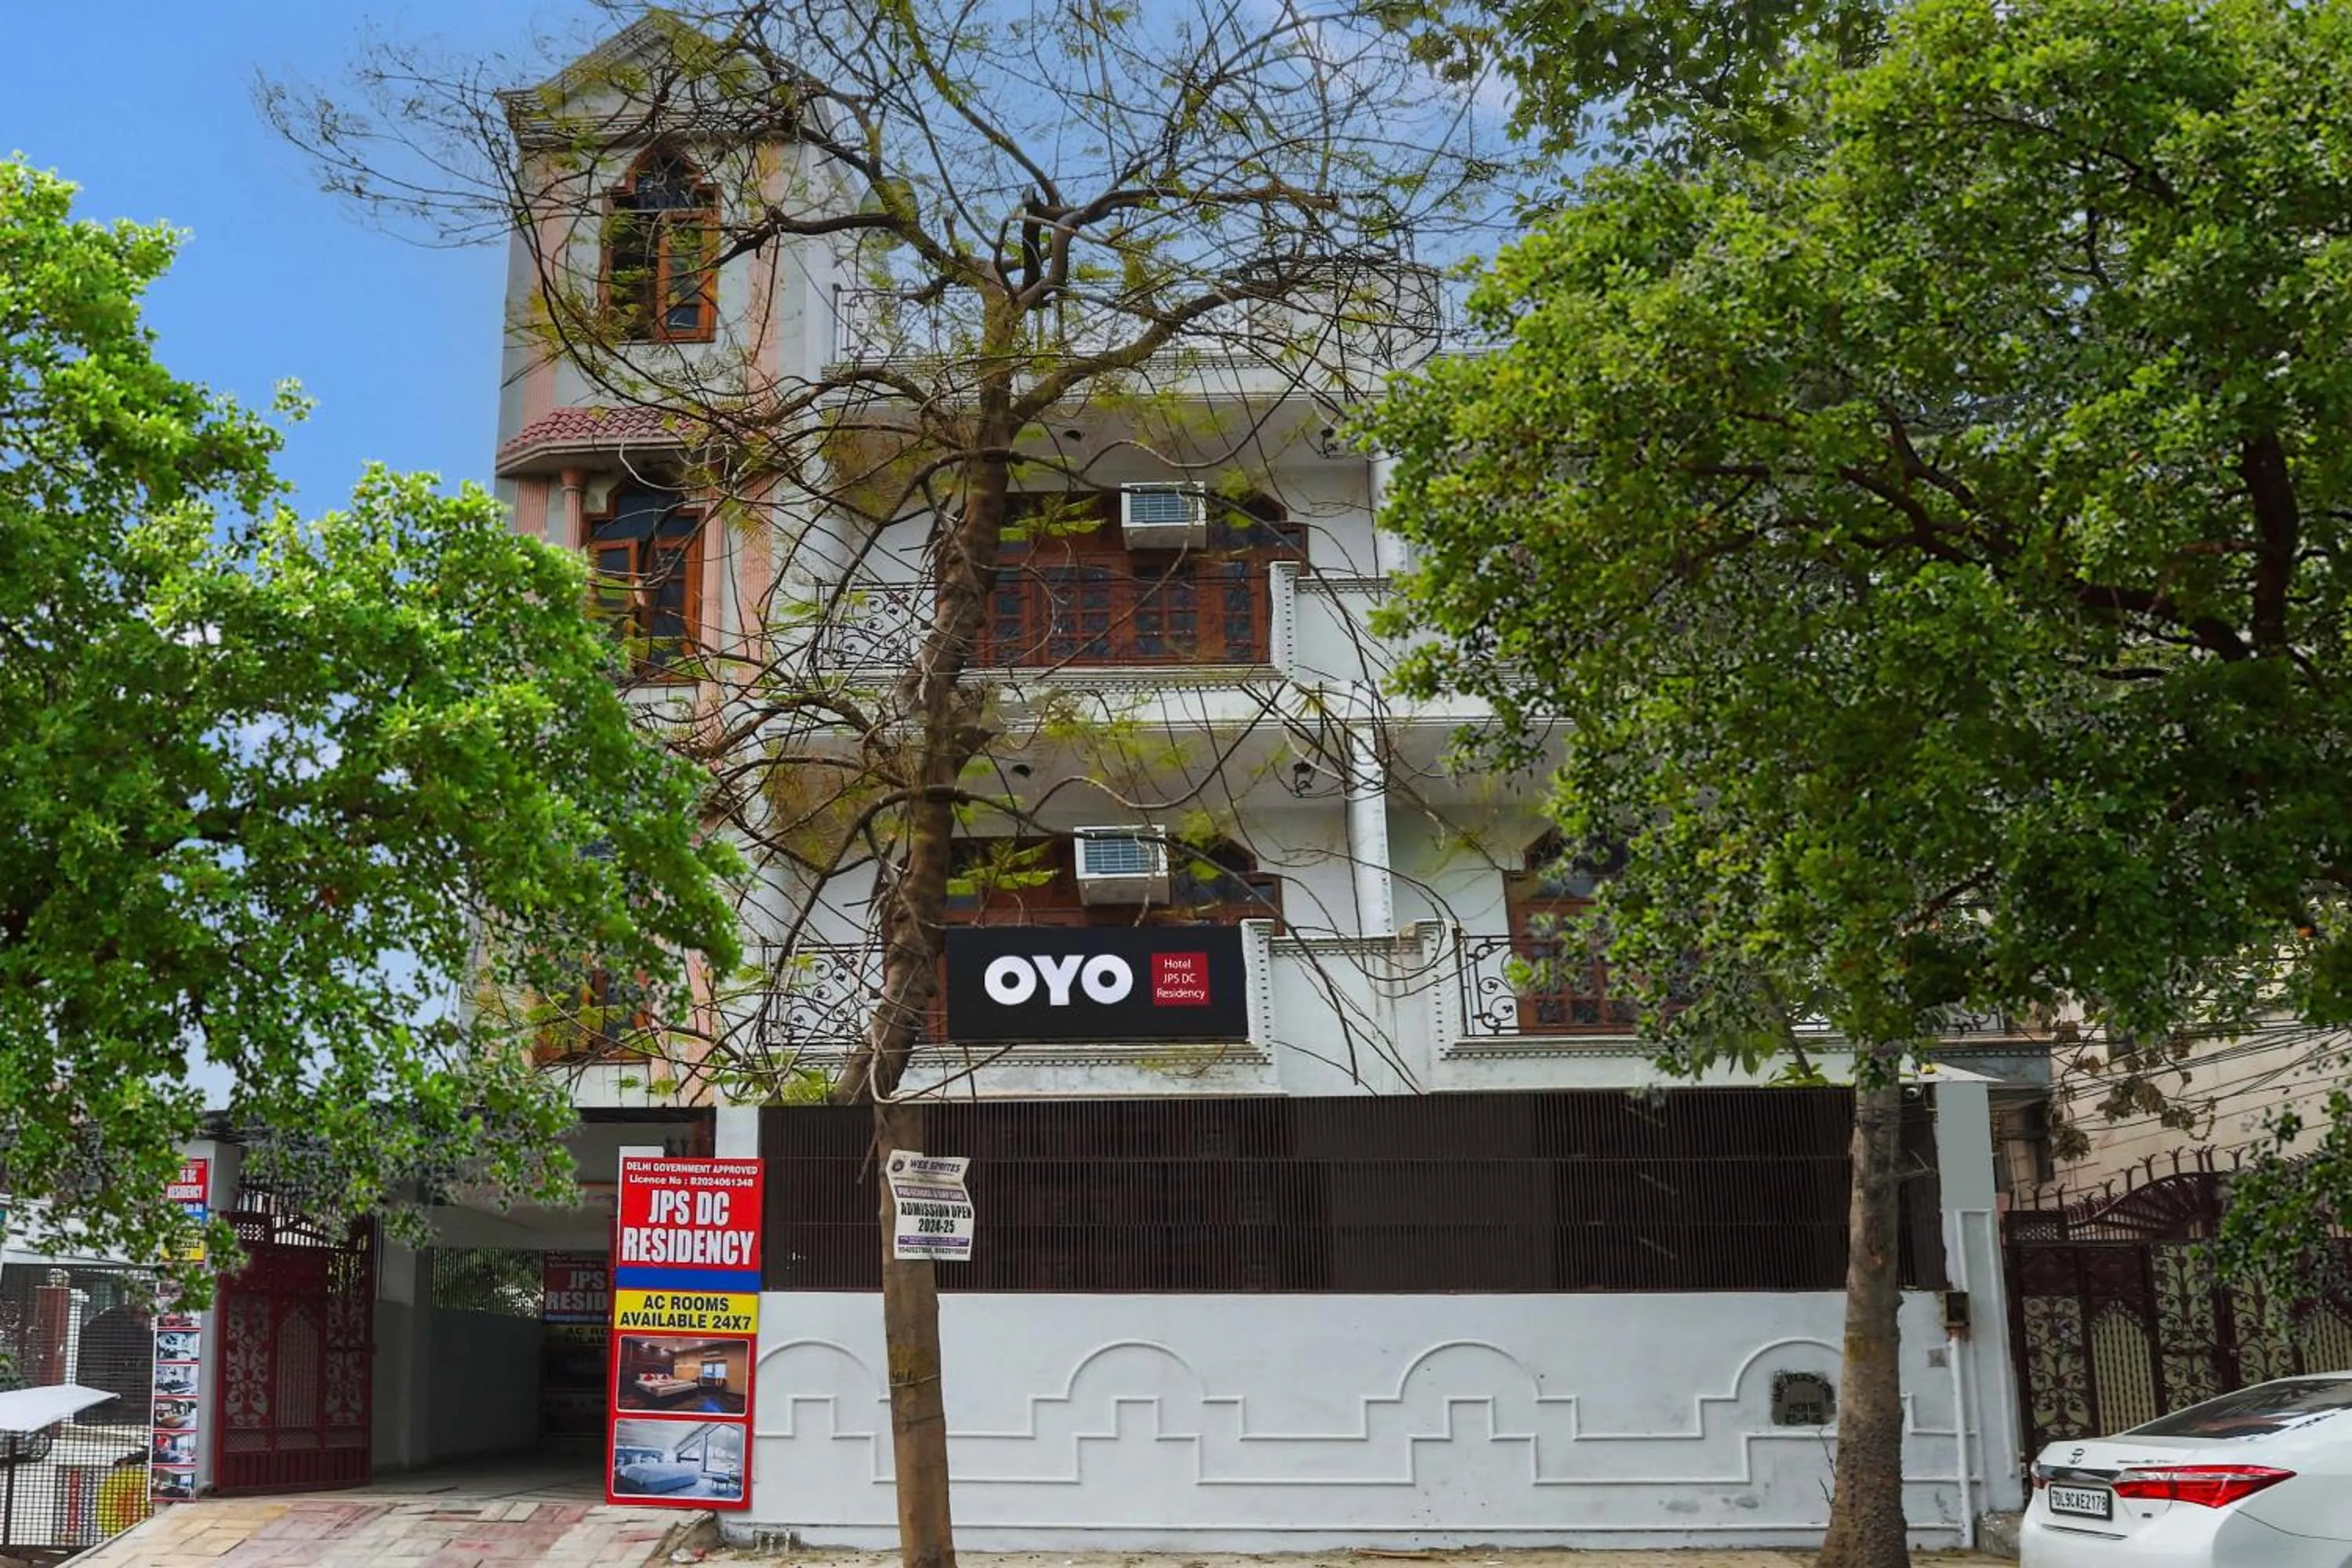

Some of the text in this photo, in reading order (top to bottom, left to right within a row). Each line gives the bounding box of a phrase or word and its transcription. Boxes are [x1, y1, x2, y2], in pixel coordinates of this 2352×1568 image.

[1163, 959, 1191, 969] Hotel
[984, 954, 1134, 1005] OYO
[1163, 973, 1196, 984] JPS DC
[1156, 988, 1205, 1000] Residency
[626, 1161, 758, 1175] DELHI GOVERNMENT APPROVED
[629, 1174, 666, 1185] Licence
[669, 1176, 682, 1185] No
[648, 1189, 730, 1226] JPS DC
[900, 1201, 972, 1219] ADMISSION OPEN
[918, 1218, 955, 1233] 2024-25
[622, 1227, 755, 1265] RESIDENCY
[567, 1270, 606, 1290] JPS
[643, 1294, 729, 1312] AC ROOMS
[620, 1312, 706, 1329] AVAILABLE
[712, 1315, 752, 1330] 24X7
